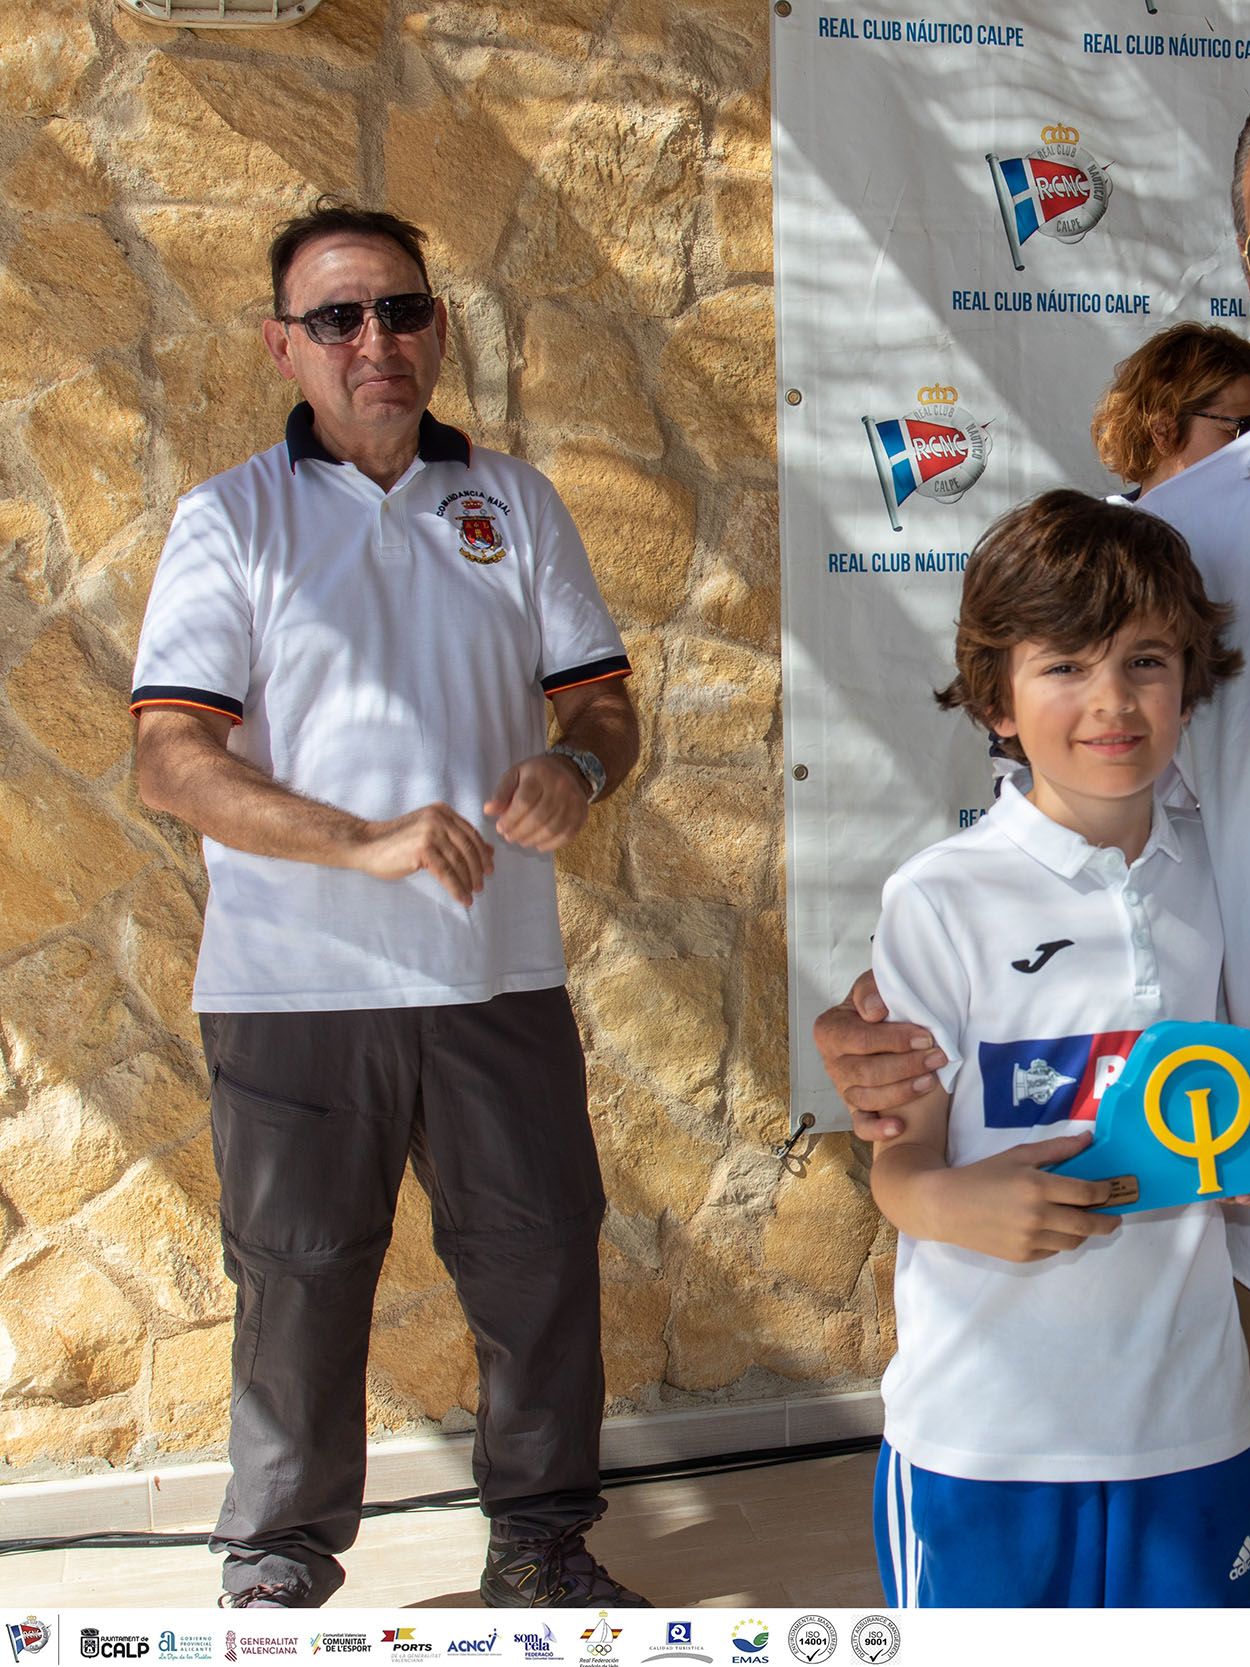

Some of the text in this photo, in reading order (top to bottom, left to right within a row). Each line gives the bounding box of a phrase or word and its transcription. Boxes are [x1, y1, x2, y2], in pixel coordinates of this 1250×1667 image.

[819, 17, 1024, 47] REAL CLUB NÁUTICO CALPE
[1084, 33, 1122, 54] REAL
[1126, 35, 1164, 56] CLUB
[1169, 34, 1231, 59] NÁUTICO
[1035, 173, 1088, 200] RCNC
[1056, 218, 1082, 232] CALPE
[953, 289, 1151, 314] REAL CLUB NÁUTICO CALPE
[1211, 298, 1246, 317] REAL
[912, 433, 966, 462] RCNC
[934, 477, 960, 492] CALPE
[487, 495, 511, 516] NAVAL
[829, 549, 969, 573] REAL CLUB NÁUTIC
